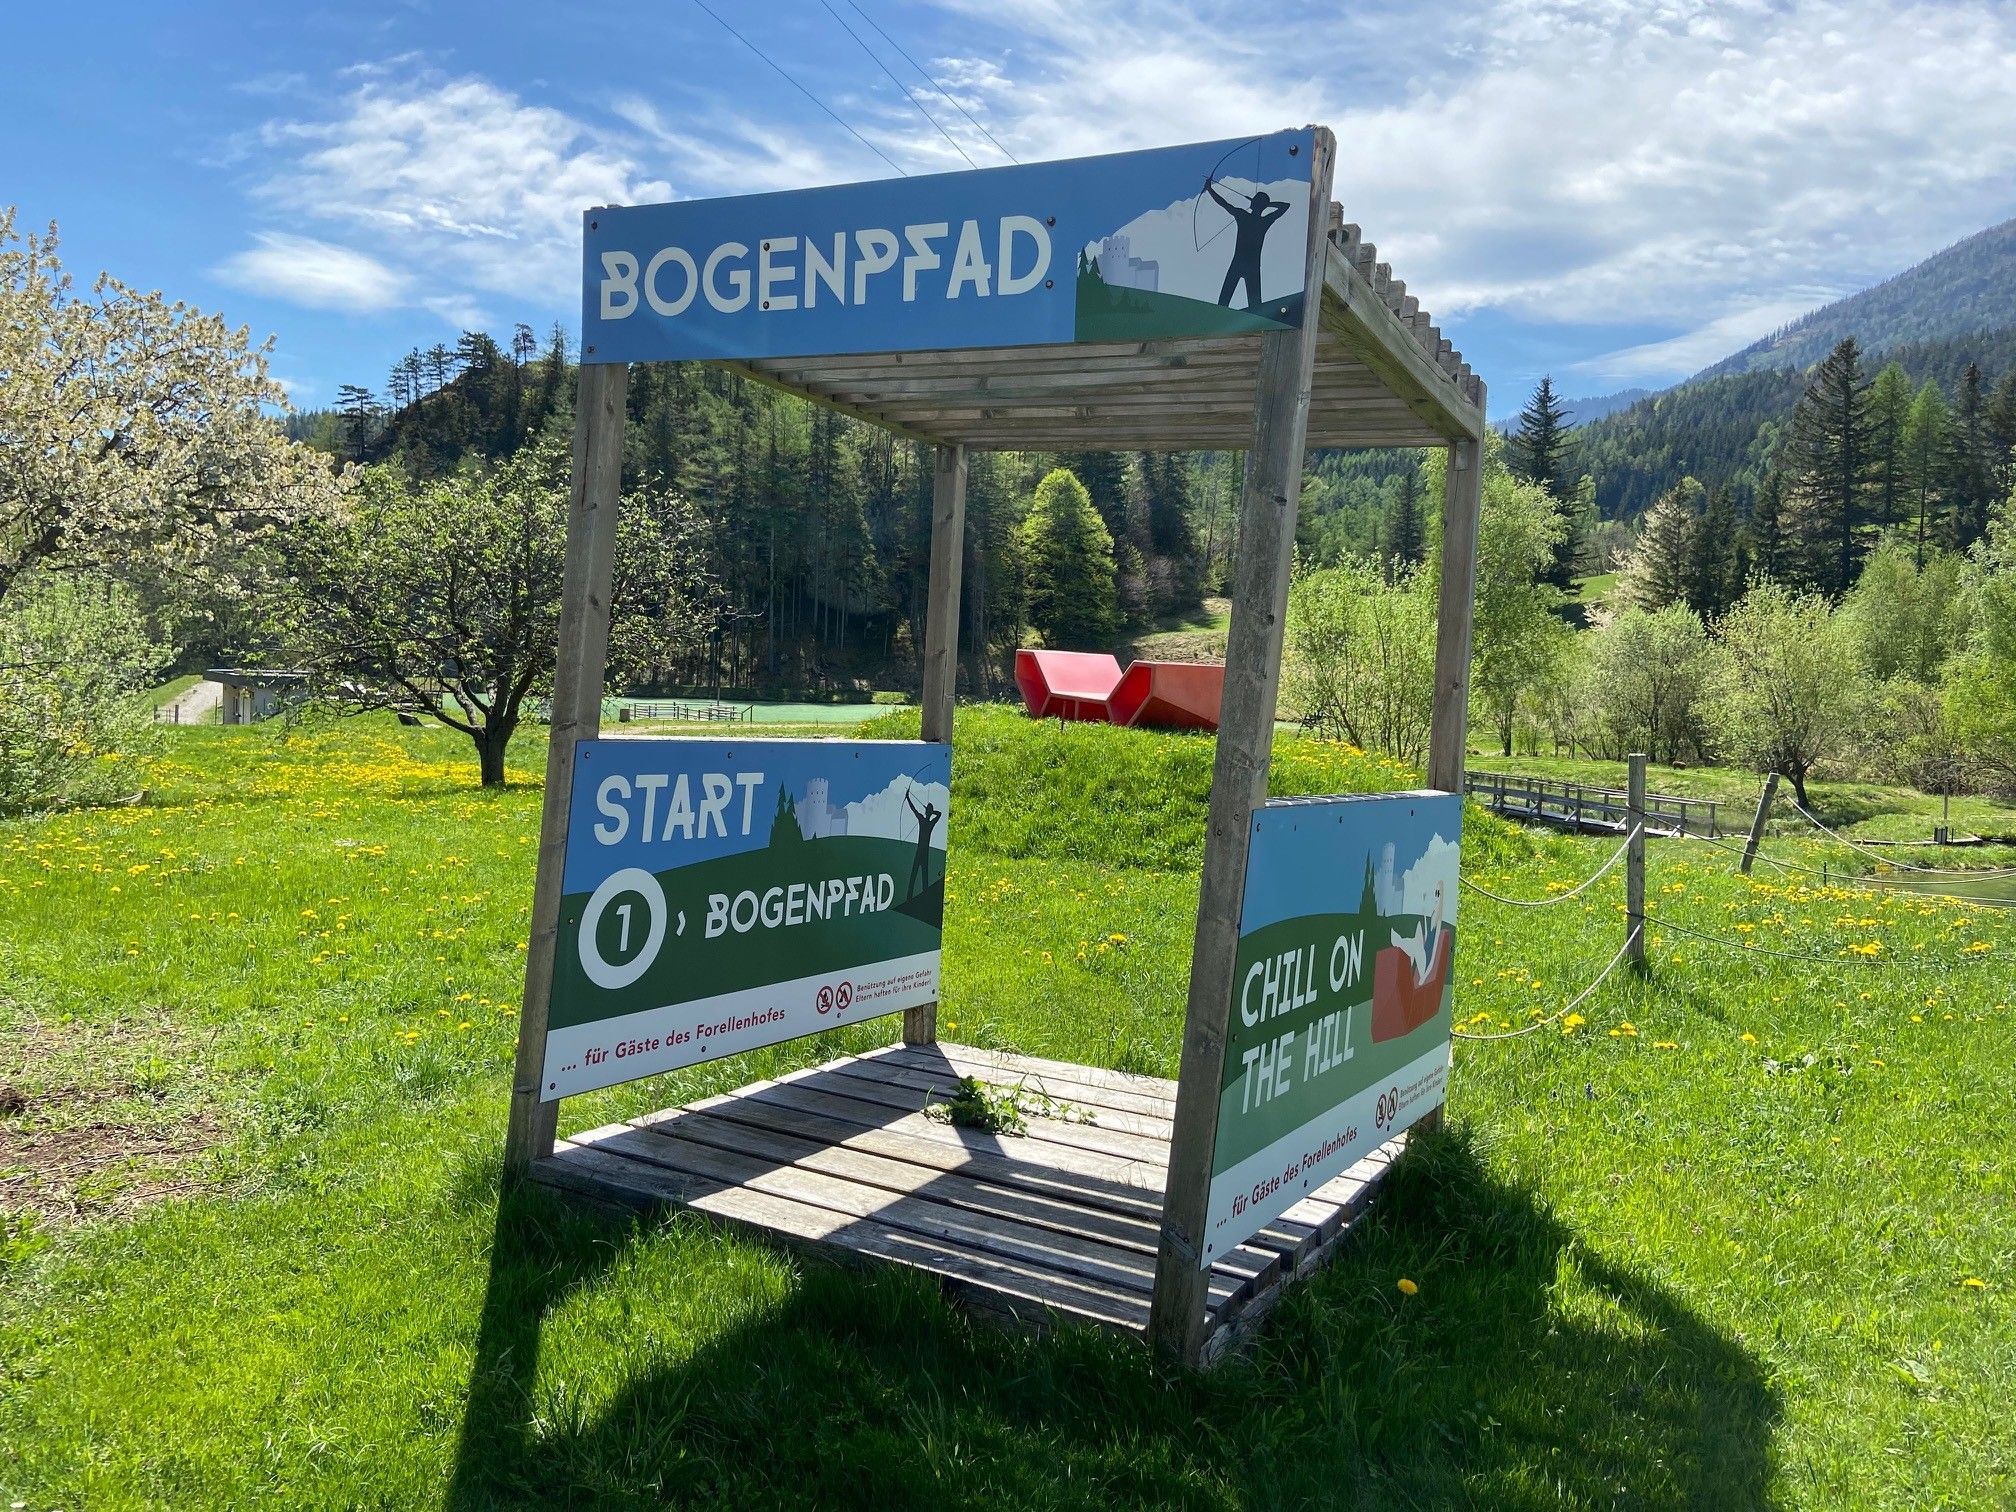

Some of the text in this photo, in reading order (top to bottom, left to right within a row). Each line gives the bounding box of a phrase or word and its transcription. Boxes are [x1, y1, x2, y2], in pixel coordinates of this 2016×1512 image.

[600, 215, 1052, 320] BOGENPFAD
[593, 772, 765, 846] START
[616, 904, 632, 952] 1
[704, 872, 895, 939] BOGENPFAD
[855, 993, 873, 1003] Eltern
[873, 989, 892, 999] haften
[892, 986, 901, 995] für
[887, 976, 896, 985] auf
[897, 974, 914, 984] eigene
[1241, 928, 1364, 1028] CHILL ON
[584, 1047, 609, 1066] für
[615, 1038, 660, 1059] Gäste
[665, 1029, 691, 1047] des
[696, 1007, 785, 1040] Forellenhofes
[1241, 1030, 1295, 1115] THE
[1303, 1005, 1354, 1083] HILL
[1232, 1193, 1249, 1218] für
[1251, 1175, 1280, 1206] Gäste
[1283, 1161, 1299, 1184] des
[1301, 1126, 1358, 1172] Forellenhofes
